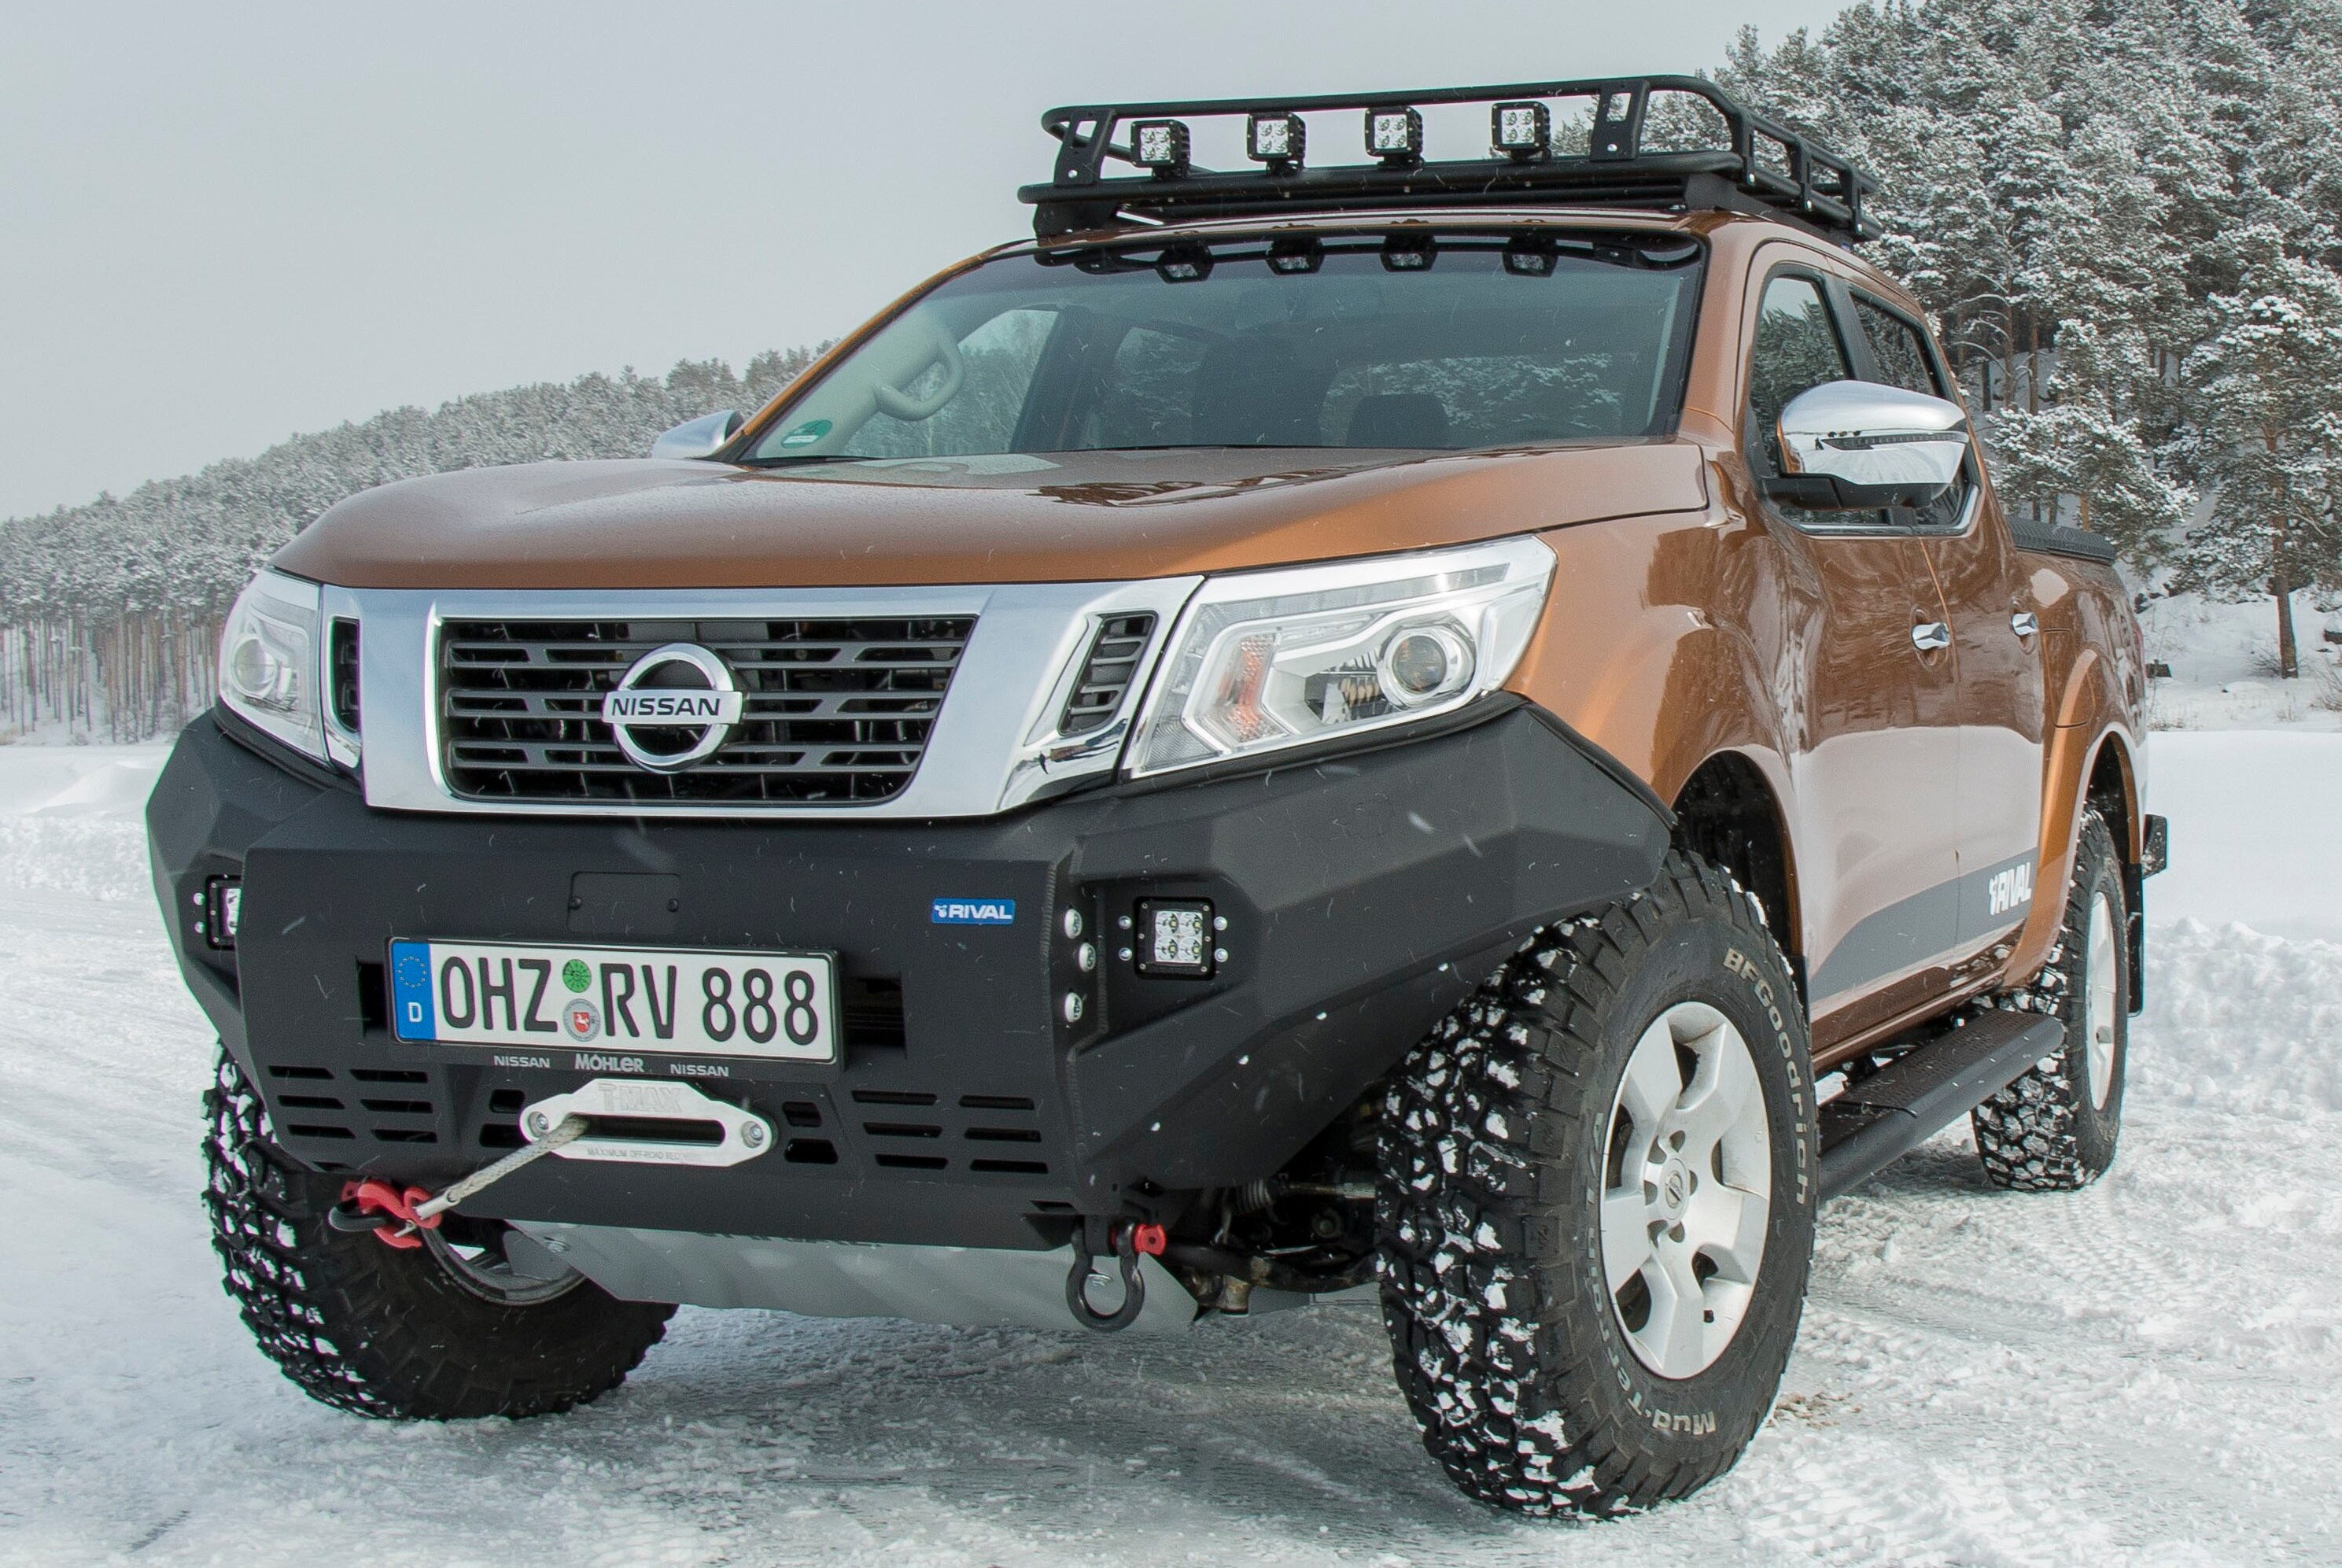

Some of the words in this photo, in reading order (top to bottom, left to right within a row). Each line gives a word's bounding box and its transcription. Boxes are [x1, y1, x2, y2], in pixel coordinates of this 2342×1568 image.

[611, 698, 721, 716] NISSAN
[1996, 861, 2032, 914] RIVAL
[948, 904, 1013, 920] RIVAL
[441, 956, 558, 1032] OHZ
[600, 963, 677, 1039] RV
[703, 967, 818, 1046] 888
[408, 1002, 422, 1023] D
[493, 1055, 551, 1068] NISSAN
[669, 1063, 729, 1077] NISSAN
